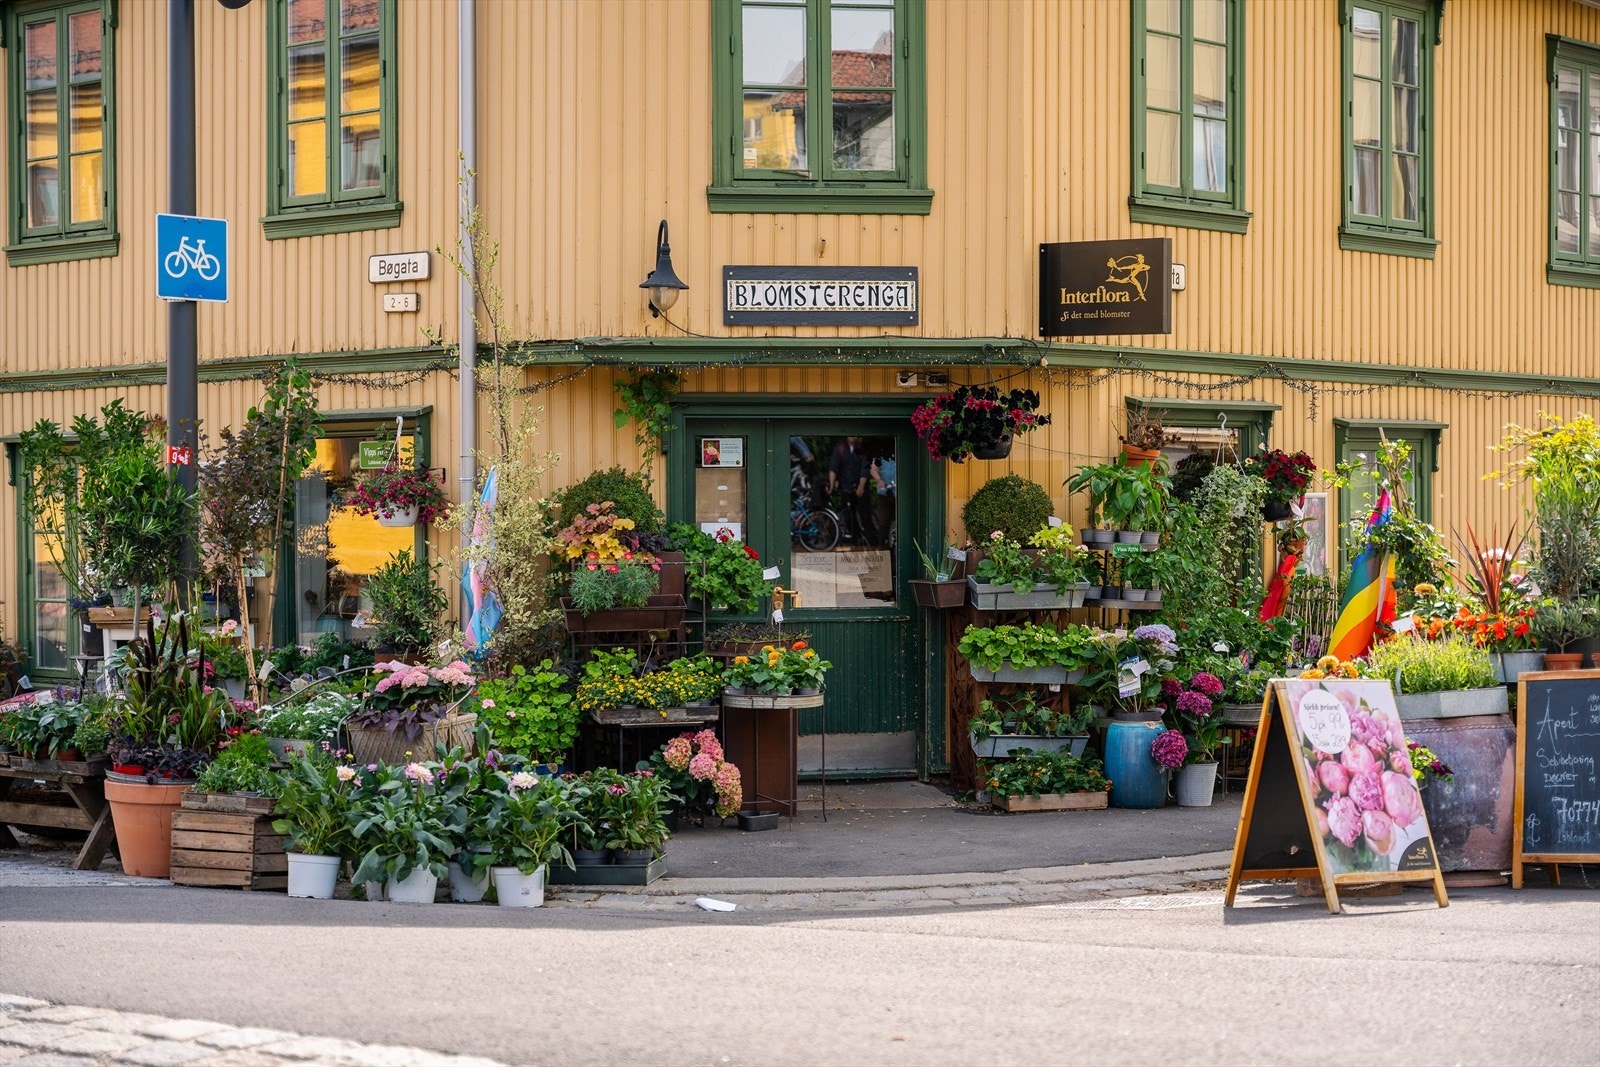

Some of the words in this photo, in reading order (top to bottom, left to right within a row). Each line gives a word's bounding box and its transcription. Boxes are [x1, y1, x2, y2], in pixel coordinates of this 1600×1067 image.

[378, 258, 418, 279] Bøgata
[734, 284, 909, 307] BLOMSTERENGA
[1060, 285, 1131, 305] Interflora
[1071, 310, 1082, 319] det
[1083, 310, 1099, 319] med
[1100, 310, 1131, 319] blomster
